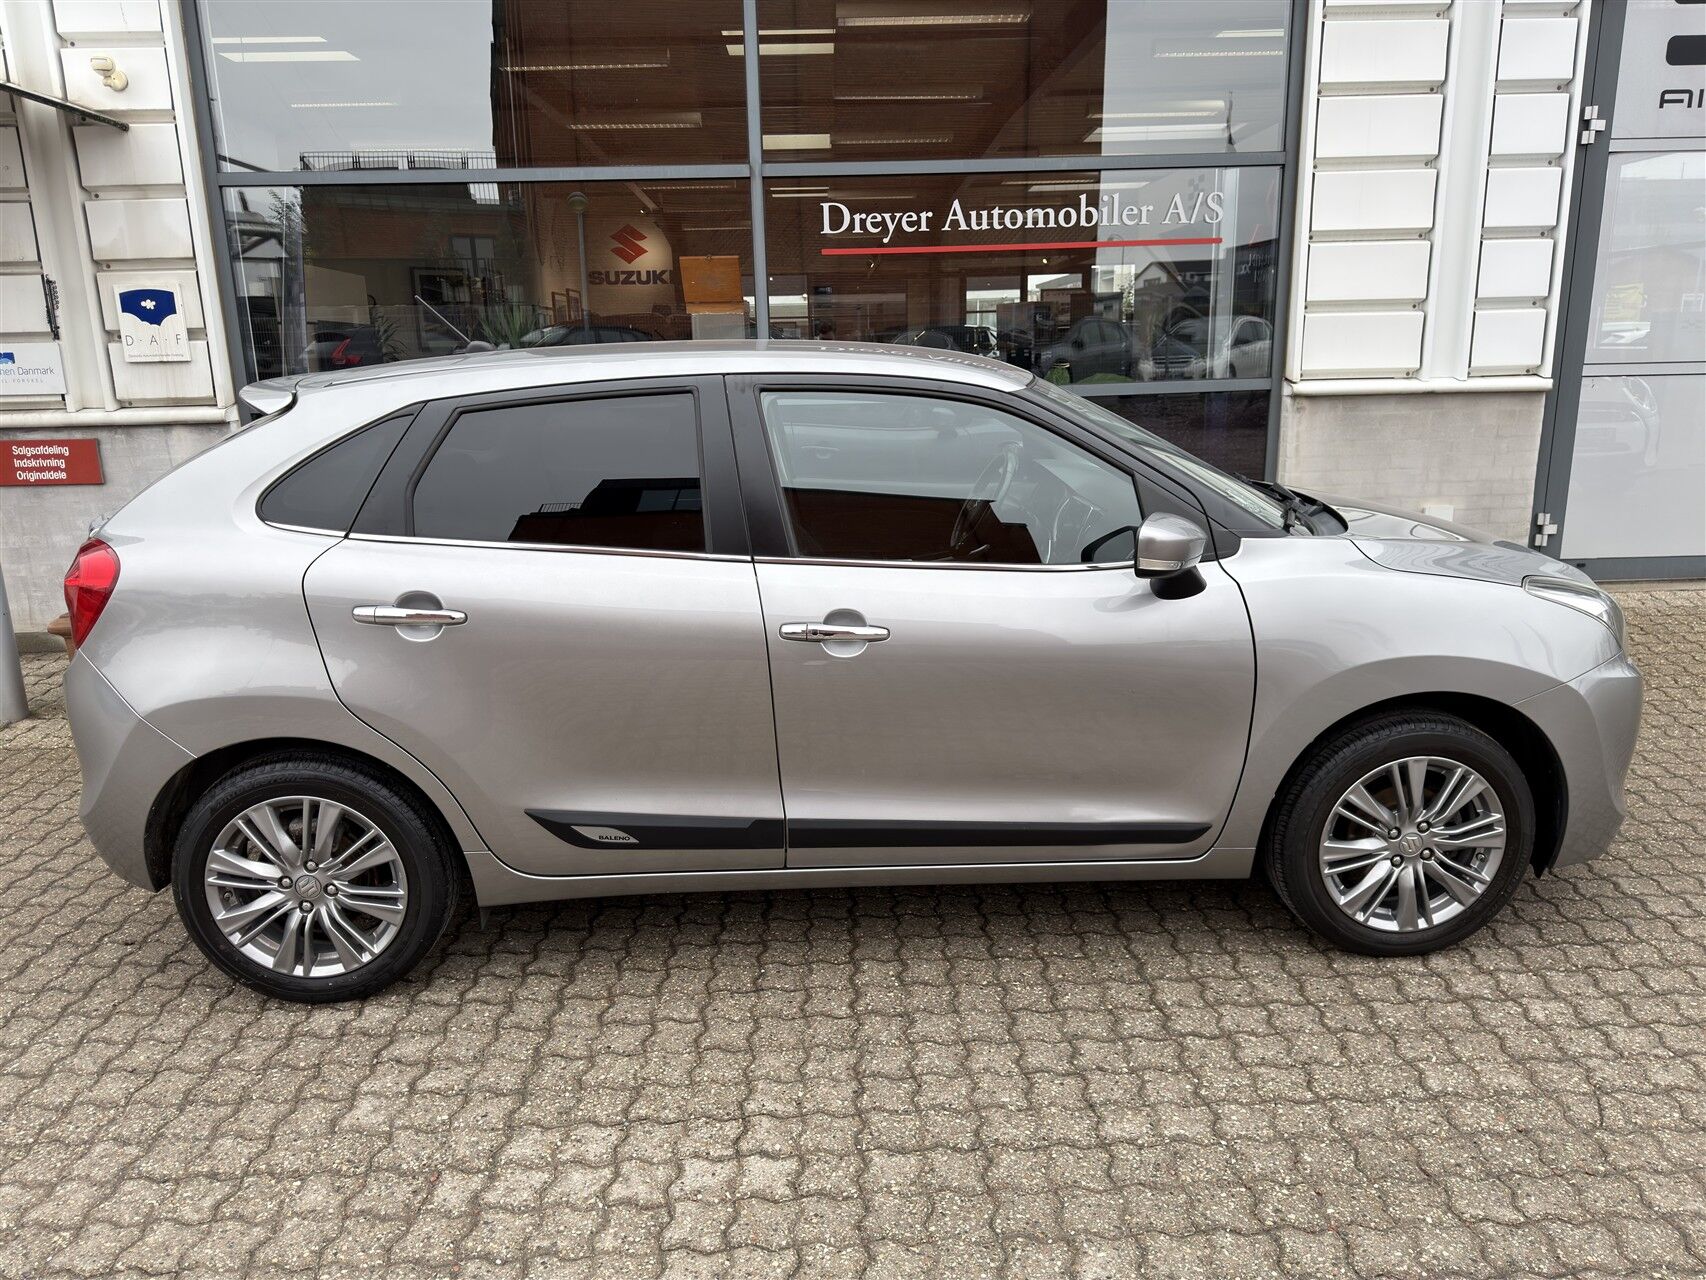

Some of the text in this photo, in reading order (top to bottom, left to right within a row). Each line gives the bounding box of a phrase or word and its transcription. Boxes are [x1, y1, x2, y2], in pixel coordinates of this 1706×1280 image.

[820, 191, 1225, 243] Dreyer Automobiler A/S
[17, 366, 55, 376] Danmark
[12, 445, 69, 457] Salgsafdeling
[13, 458, 66, 469] Indskrivning
[16, 470, 67, 482] Originaldele
